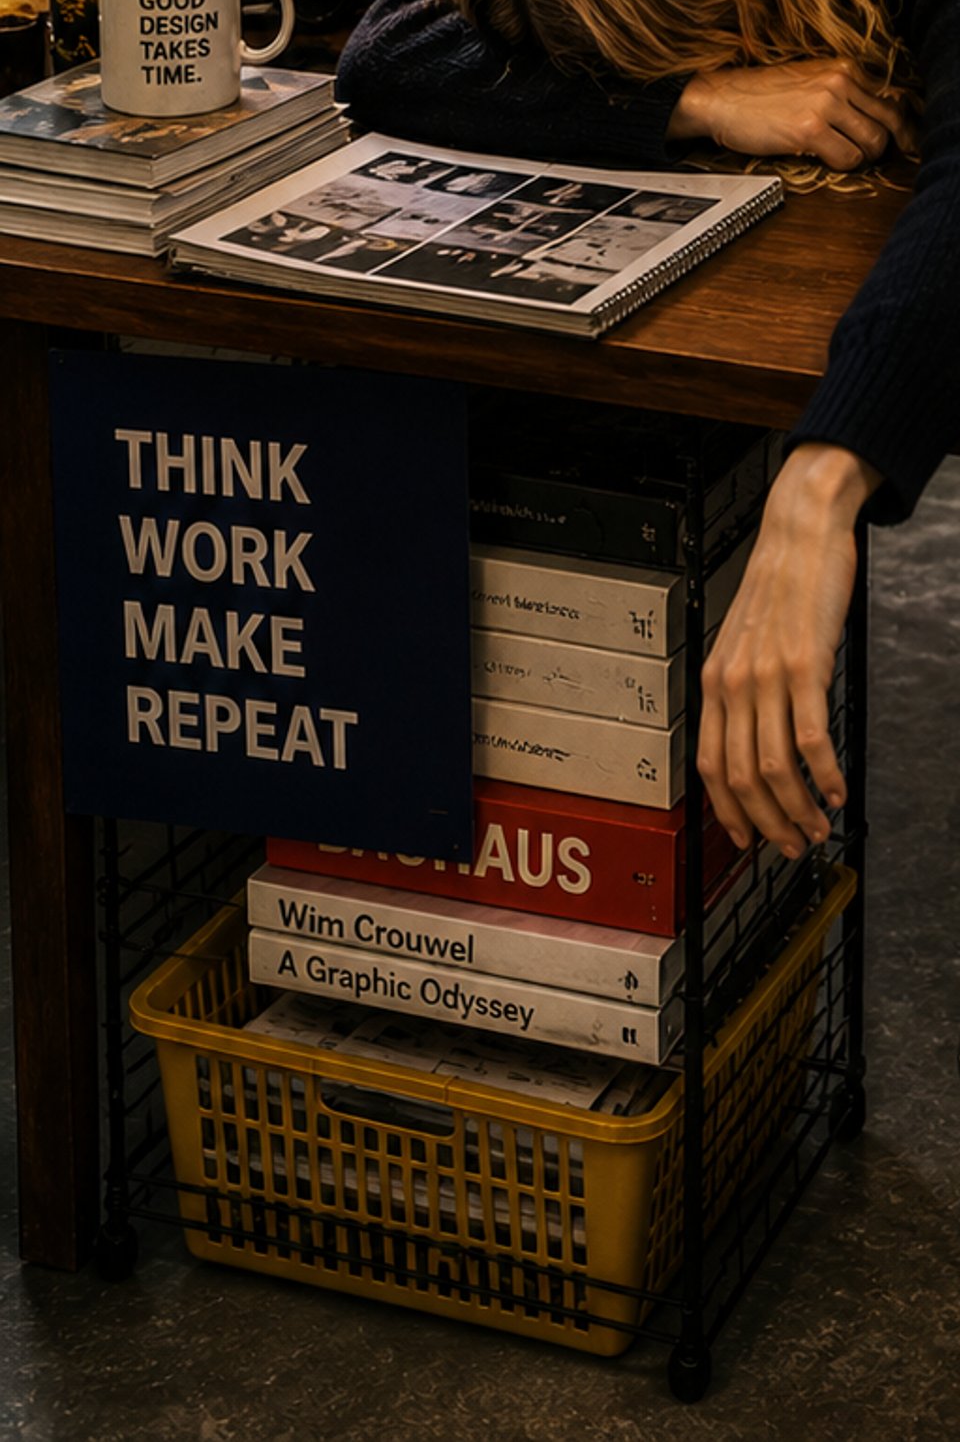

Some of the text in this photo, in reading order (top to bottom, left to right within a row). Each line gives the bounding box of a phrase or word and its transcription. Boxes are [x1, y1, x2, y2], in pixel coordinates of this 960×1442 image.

[139, 11, 219, 36] DESIGN
[139, 38, 211, 61] TAKES
[141, 64, 202, 86] TIME.
[114, 428, 311, 505] THINK
[118, 514, 316, 593] WORK
[123, 600, 306, 678] MAKE
[126, 685, 358, 770] REPEAT
[278, 898, 474, 964] Wim Crouwel
[277, 949, 535, 1031] A Graphic Odyssey
